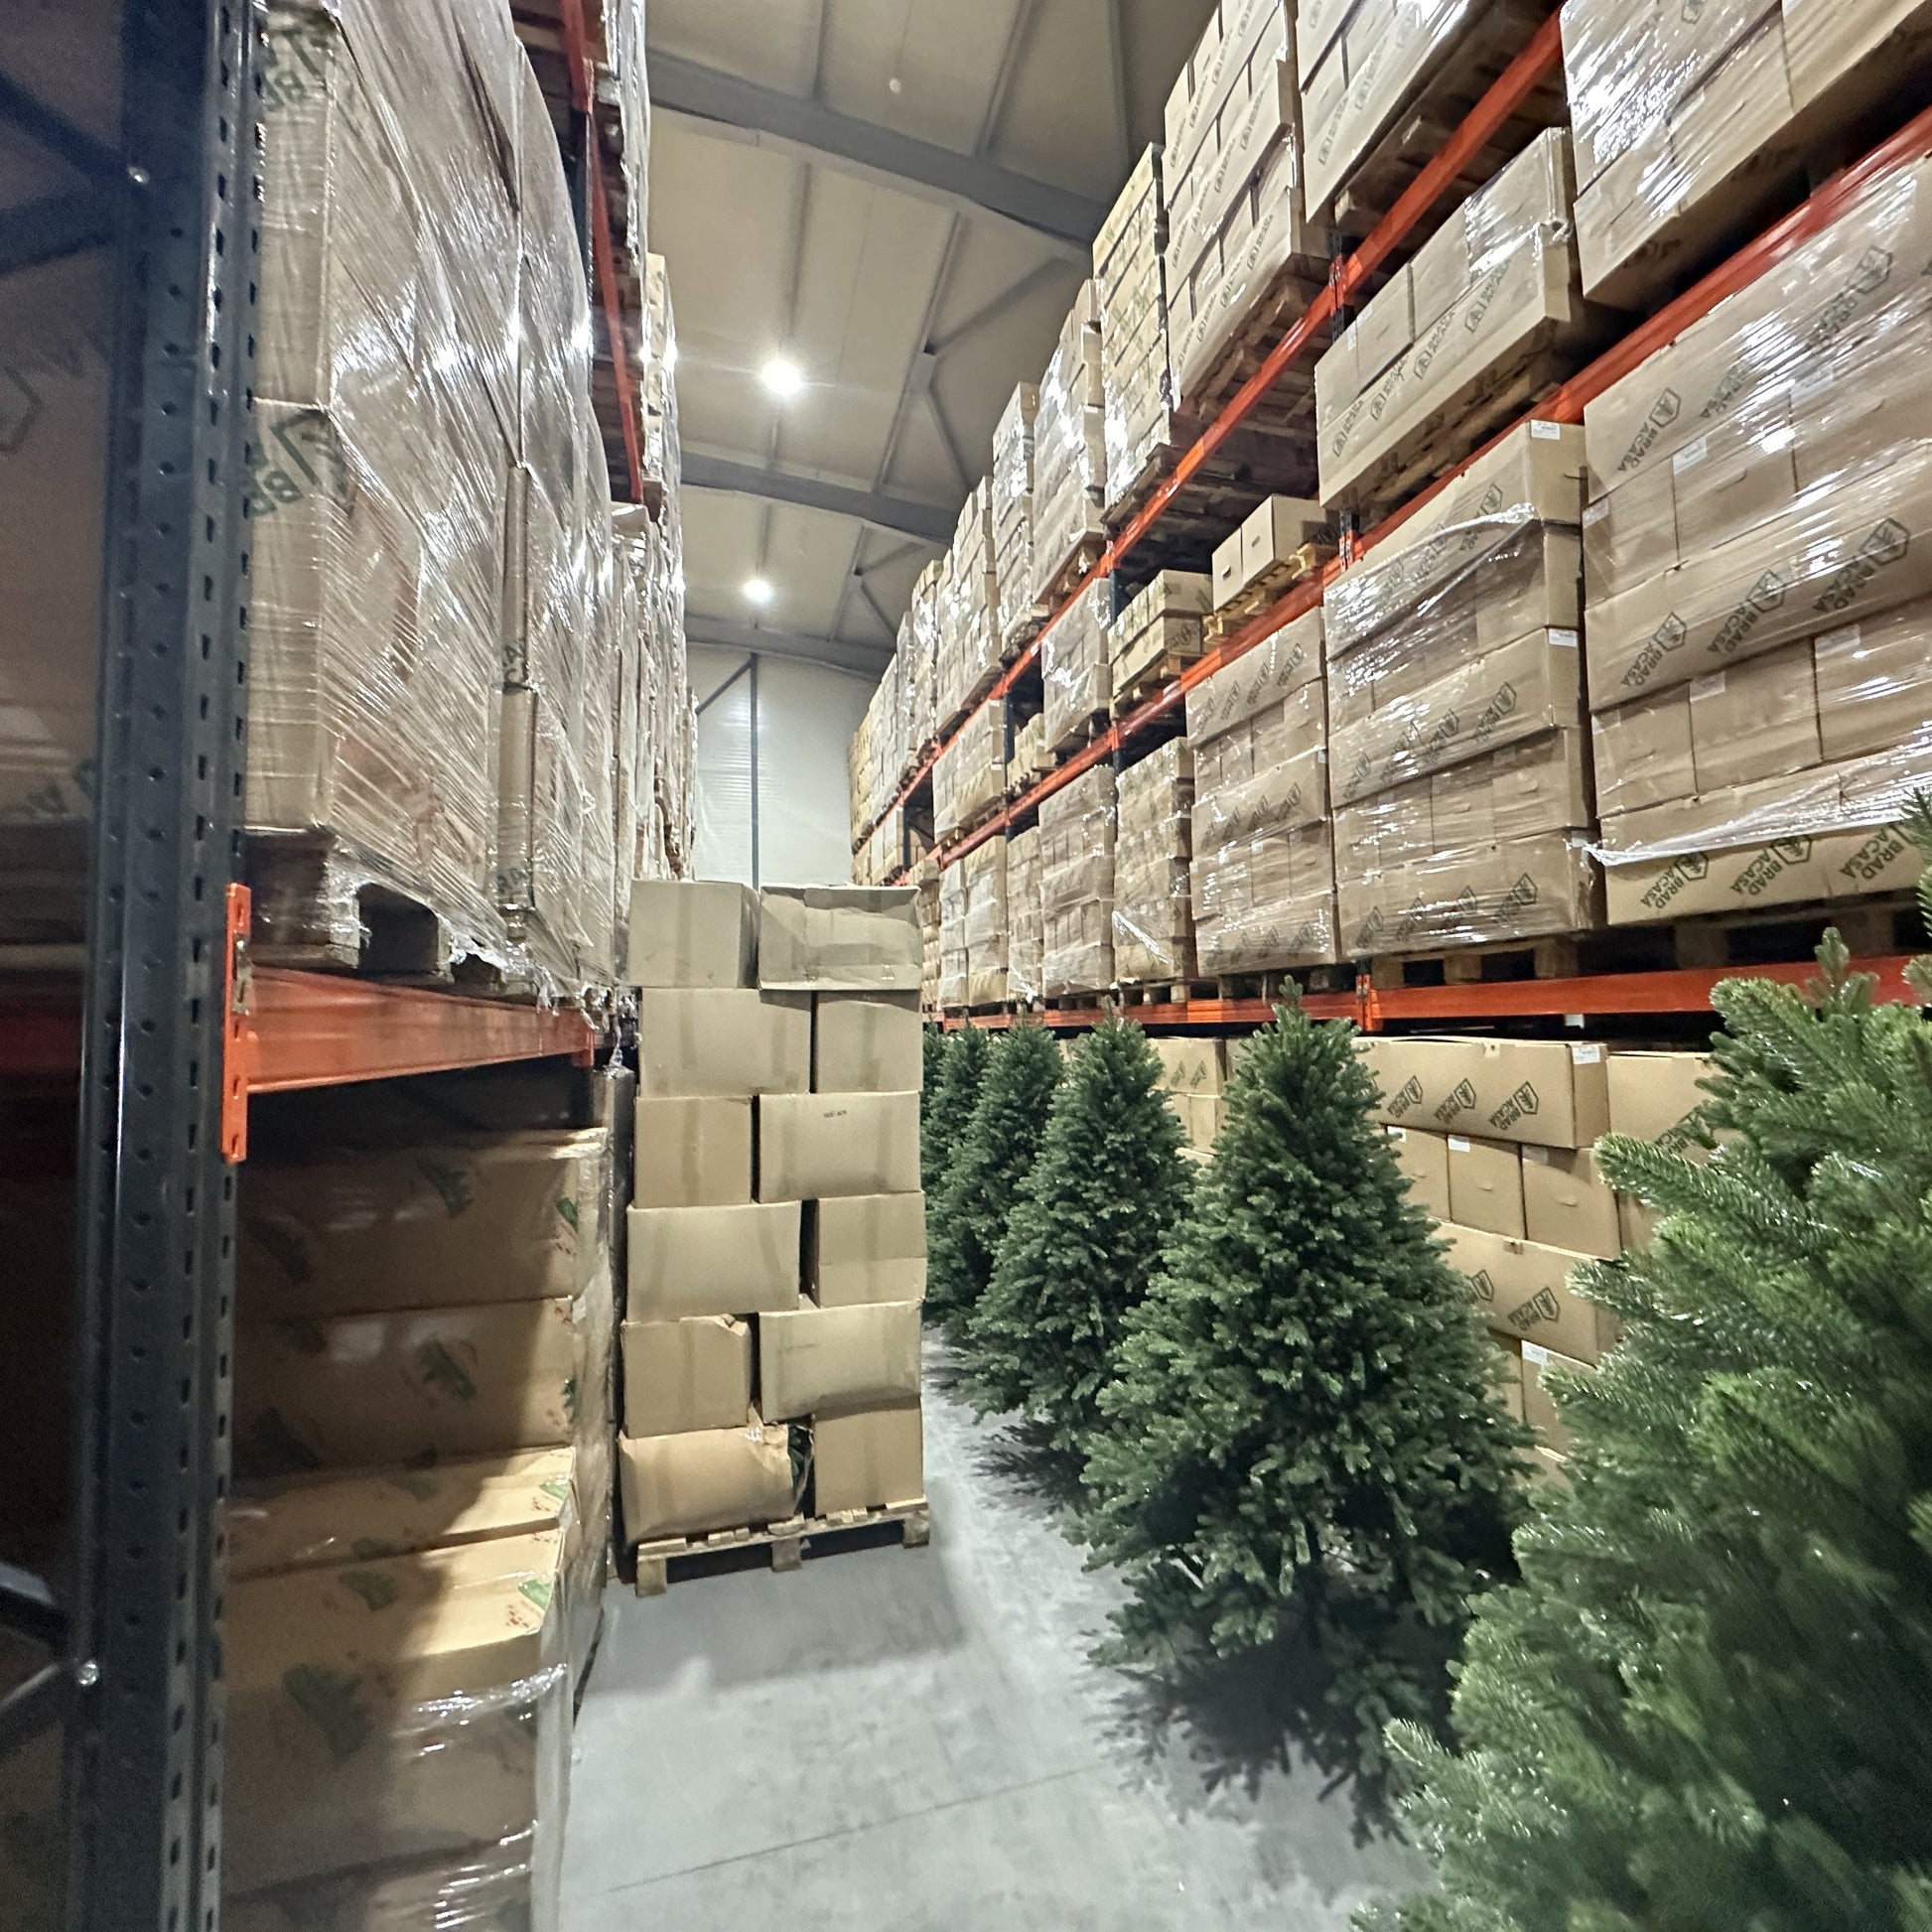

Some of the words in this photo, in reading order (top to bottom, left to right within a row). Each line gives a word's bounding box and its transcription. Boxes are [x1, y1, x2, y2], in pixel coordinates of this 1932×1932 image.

[1706, 603, 1745, 652] ACASA
[1724, 611, 1757, 650] BRAD
[1620, 641, 1653, 685] ACASA
[1634, 649, 1663, 685] BRAD
[1728, 848, 1768, 896] ACASA
[1838, 827, 1886, 879] ACASA
[1860, 839, 1904, 881] BRAD
[1638, 865, 1673, 906] ACASA
[1653, 875, 1685, 908] BRAD
[1746, 859, 1782, 896] BRAD
[1488, 1097, 1513, 1128] ACASA
[1497, 1108, 1521, 1131] BRAD
